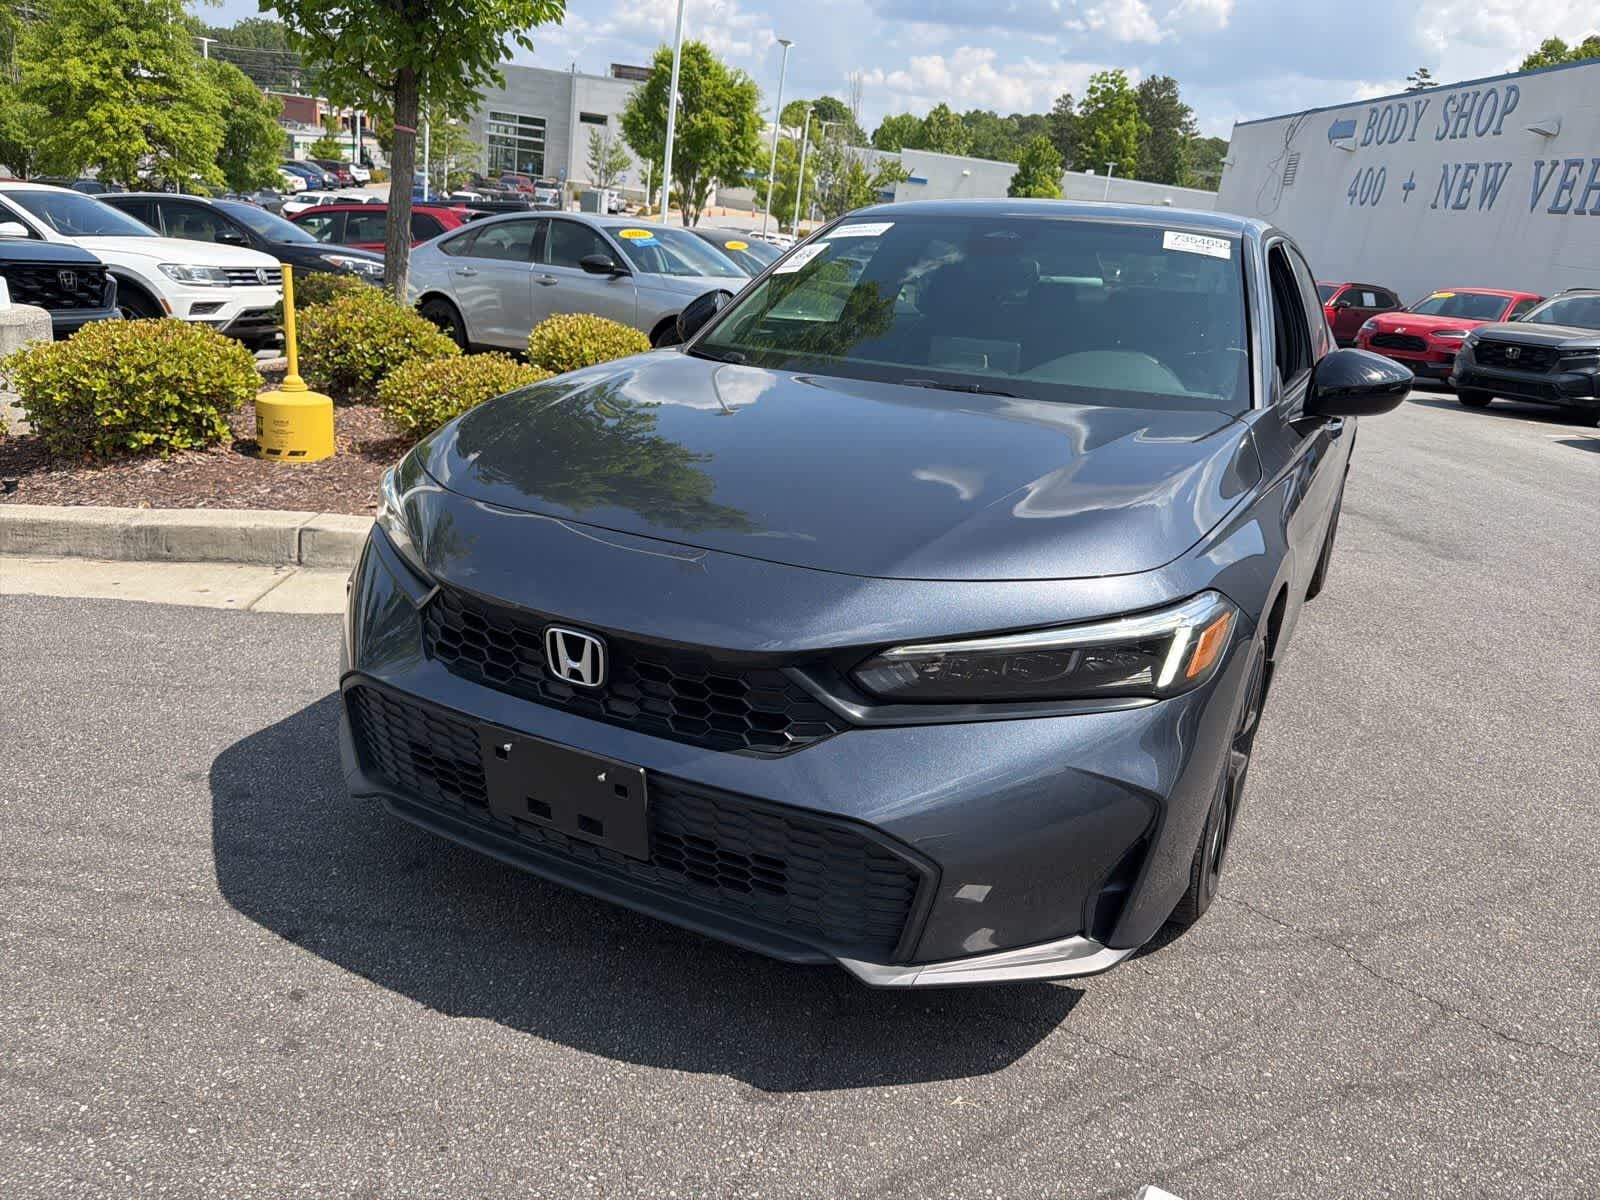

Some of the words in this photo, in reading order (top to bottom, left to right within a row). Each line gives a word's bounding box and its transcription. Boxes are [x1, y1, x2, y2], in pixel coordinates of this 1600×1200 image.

[1360, 99, 1431, 146] BODY
[1435, 85, 1520, 141] SHOP
[1347, 166, 1386, 206] 400
[1430, 161, 1512, 211] NEW
